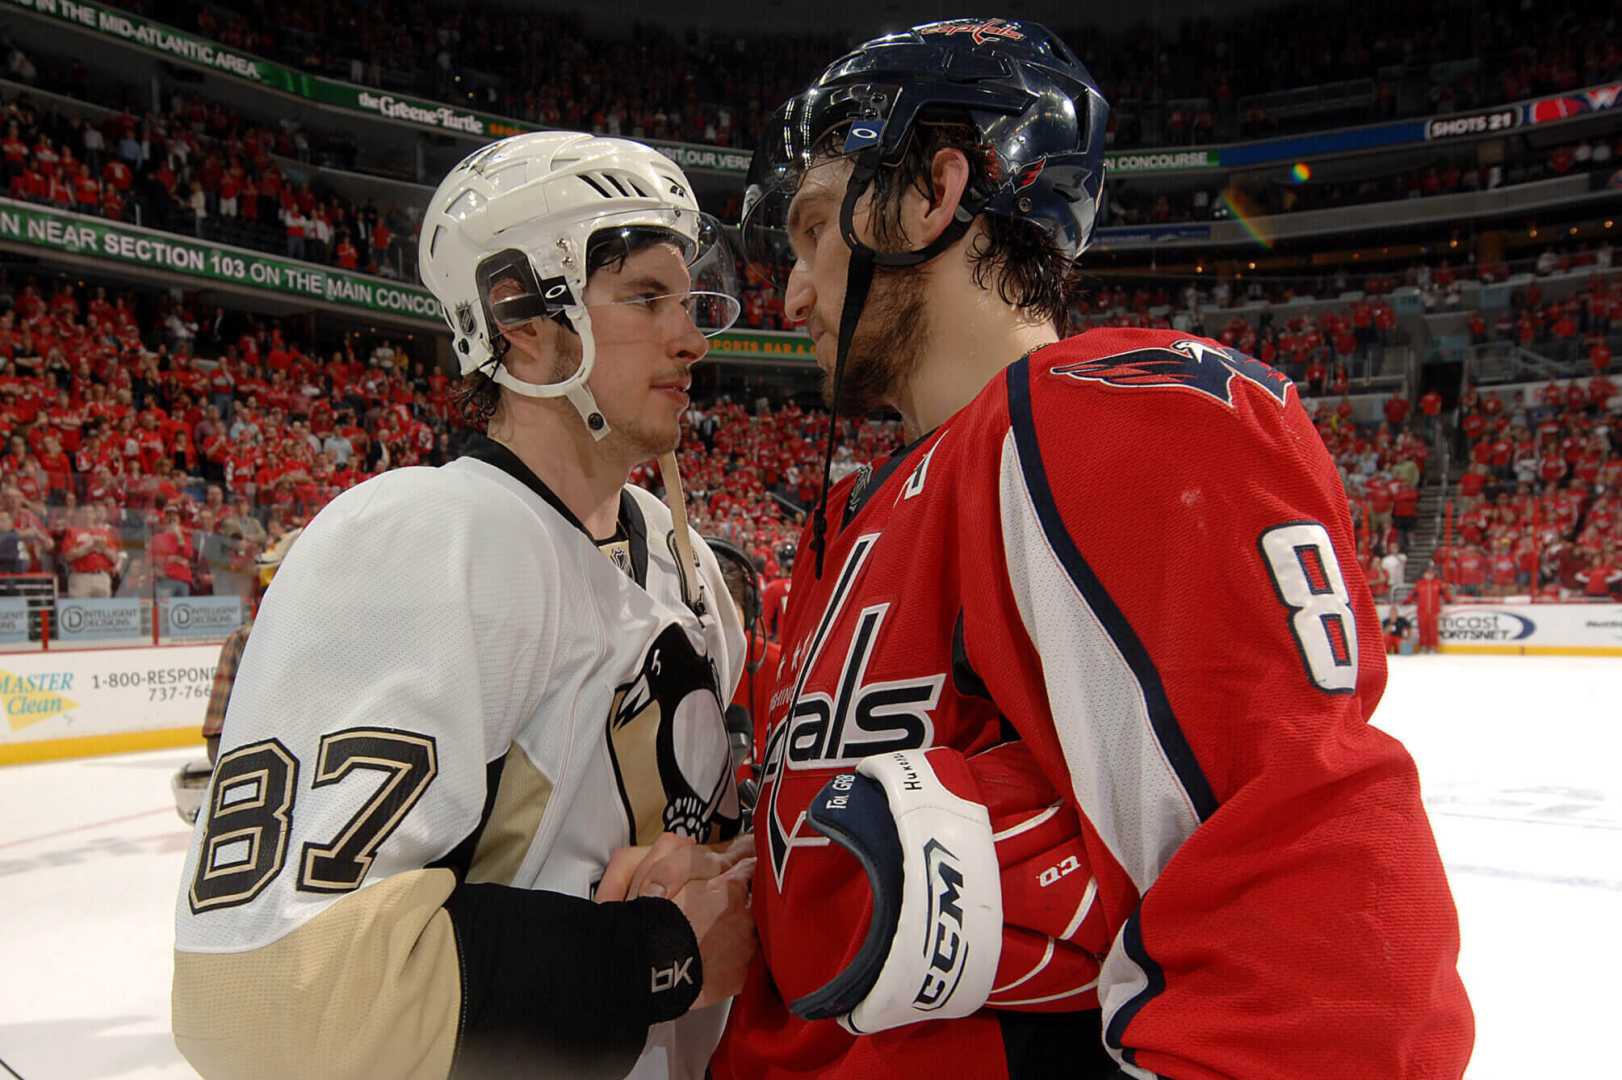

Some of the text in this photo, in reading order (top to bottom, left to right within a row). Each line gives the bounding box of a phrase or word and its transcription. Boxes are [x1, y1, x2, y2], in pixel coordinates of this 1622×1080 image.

[62, 1, 97, 26] THE
[99, 12, 213, 64] MID-ATLANTIC
[1118, 151, 1208, 169] CONCOURSE
[1431, 115, 1487, 137] SHOTS
[27, 218, 98, 251] NEAR
[104, 233, 204, 271] SECTION
[210, 255, 245, 278] 103
[250, 263, 280, 286] ON
[285, 269, 323, 294] THE
[327, 278, 372, 303] MAIN
[1260, 522, 1358, 694] 8
[8, 695, 61, 716] Clean
[189, 726, 437, 915] 87
[913, 860, 964, 1005] CCM
